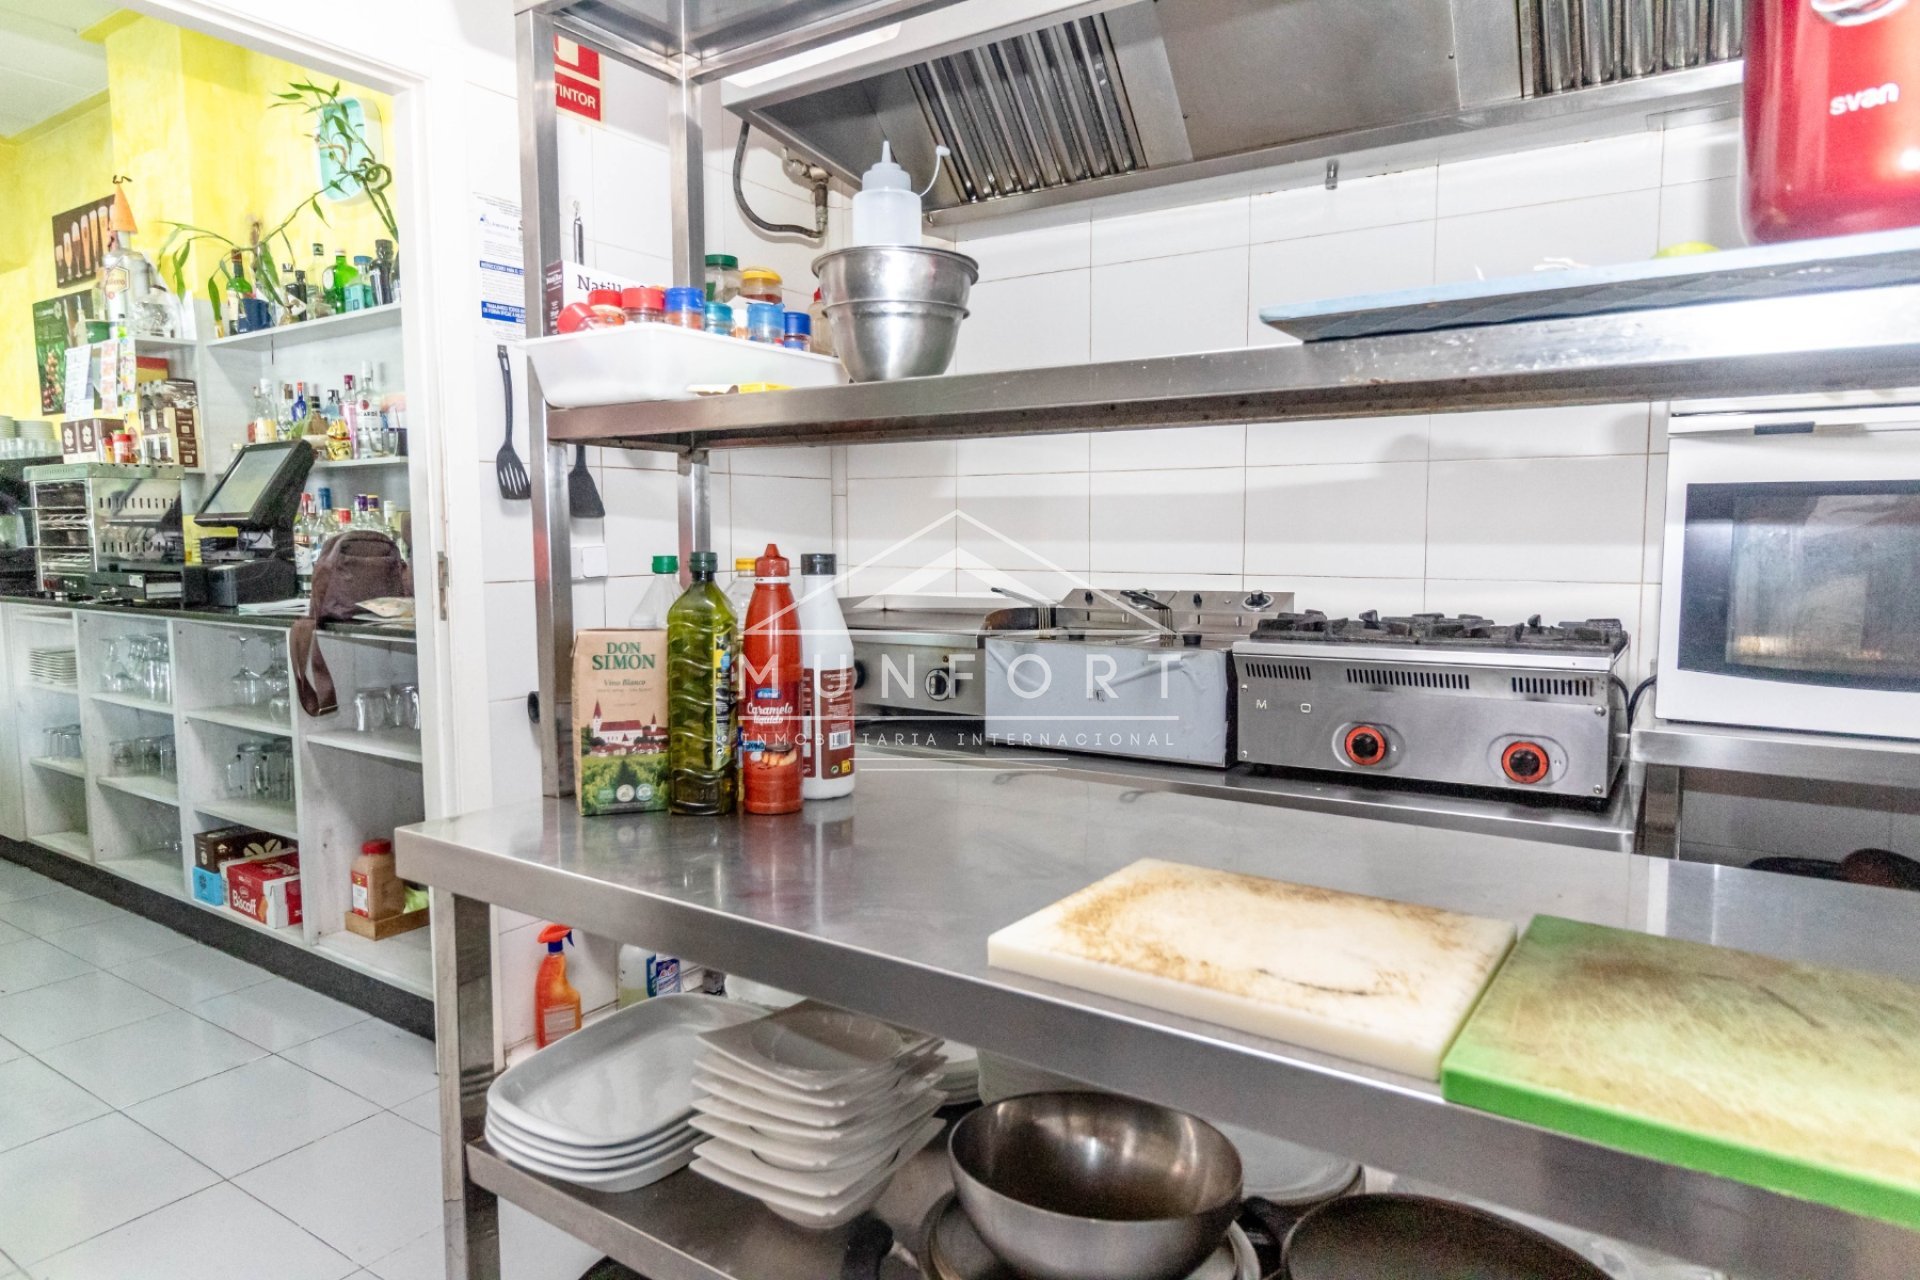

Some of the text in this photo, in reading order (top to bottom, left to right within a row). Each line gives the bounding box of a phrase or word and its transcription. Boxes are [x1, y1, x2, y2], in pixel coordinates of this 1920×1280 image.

[1829, 82, 1900, 115] svan
[607, 642, 641, 654] DON
[592, 654, 656, 670] SIMON
[747, 702, 793, 715] Caramelo
[232, 889, 257, 915] Biscoff
